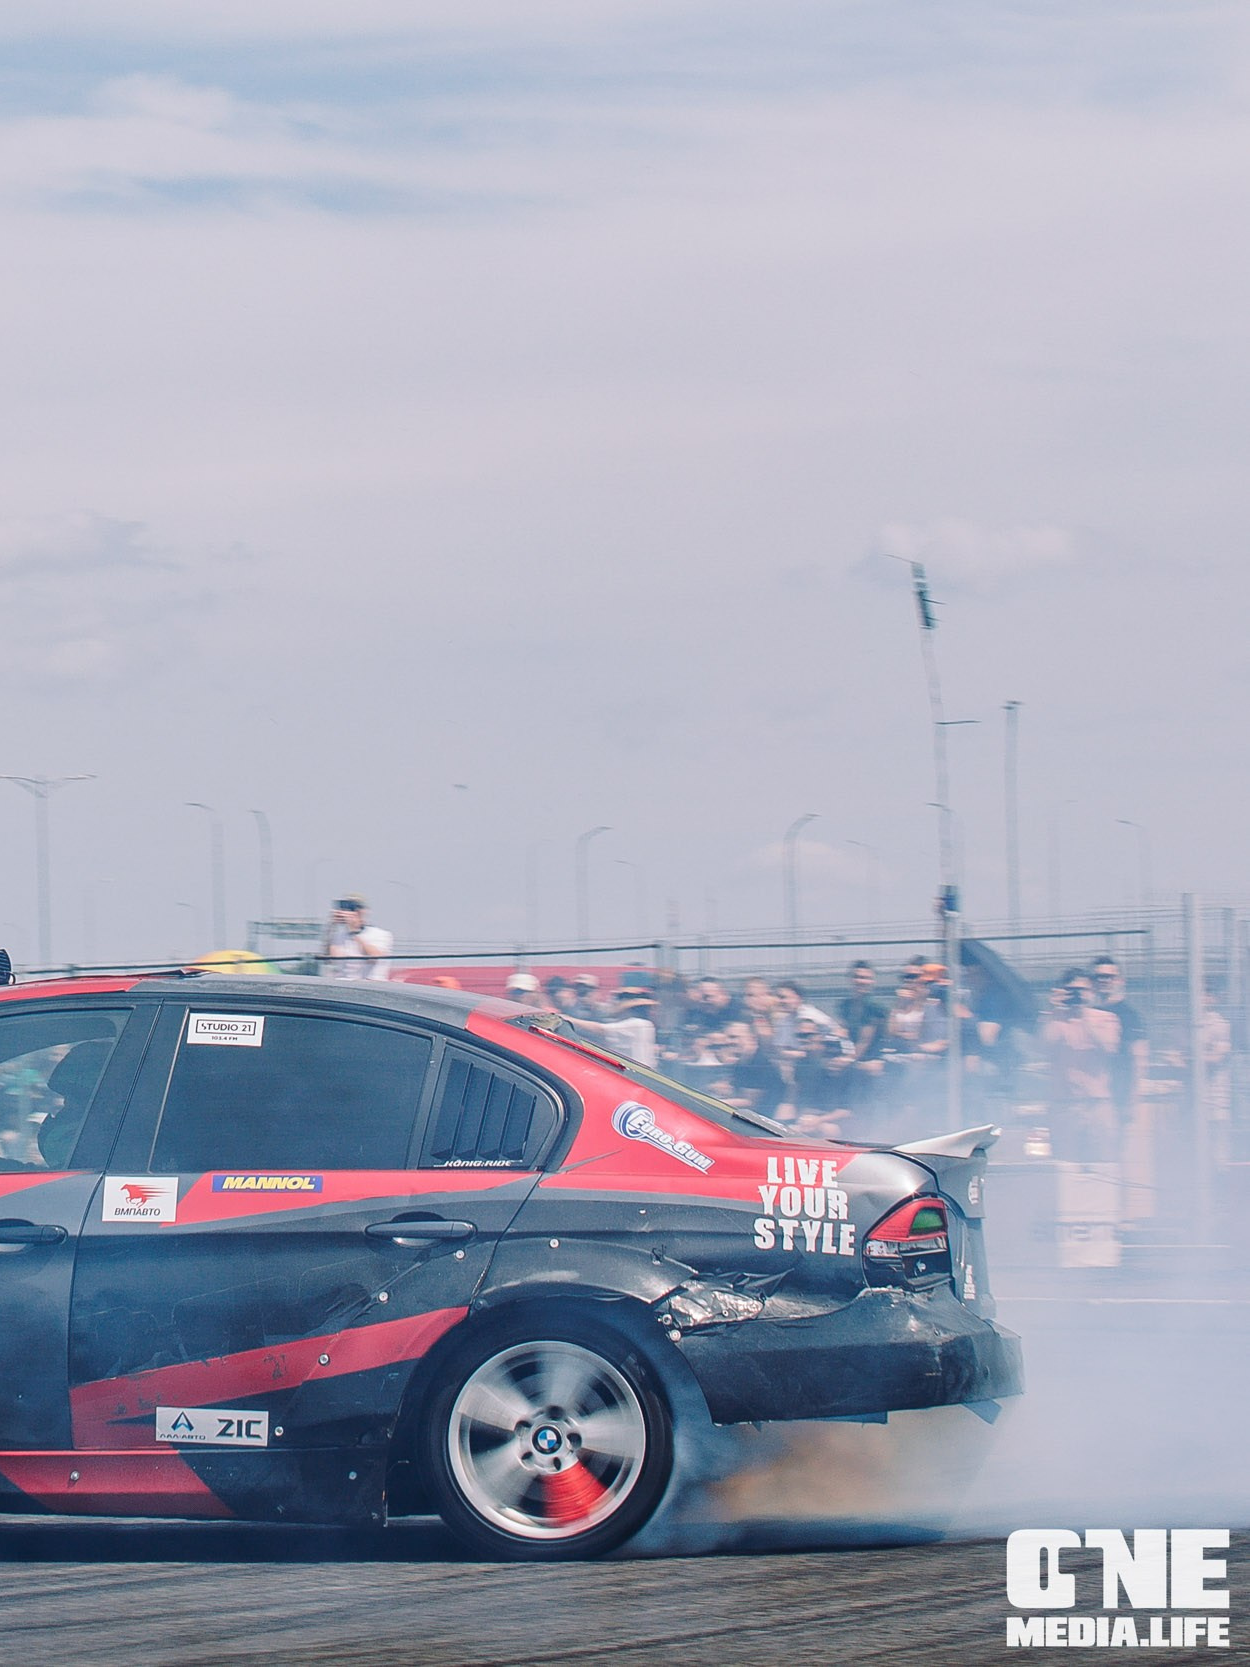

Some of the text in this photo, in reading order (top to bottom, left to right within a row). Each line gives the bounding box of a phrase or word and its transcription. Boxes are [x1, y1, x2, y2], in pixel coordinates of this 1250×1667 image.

[201, 1022, 252, 1032] STUDIO 21
[766, 1156, 838, 1188] LIVE
[222, 1176, 315, 1190] MANNOL
[114, 1207, 161, 1217] ВМПАВТО
[758, 1184, 848, 1220] YOUR
[753, 1218, 856, 1256] STYLE
[215, 1418, 263, 1439] ZIC
